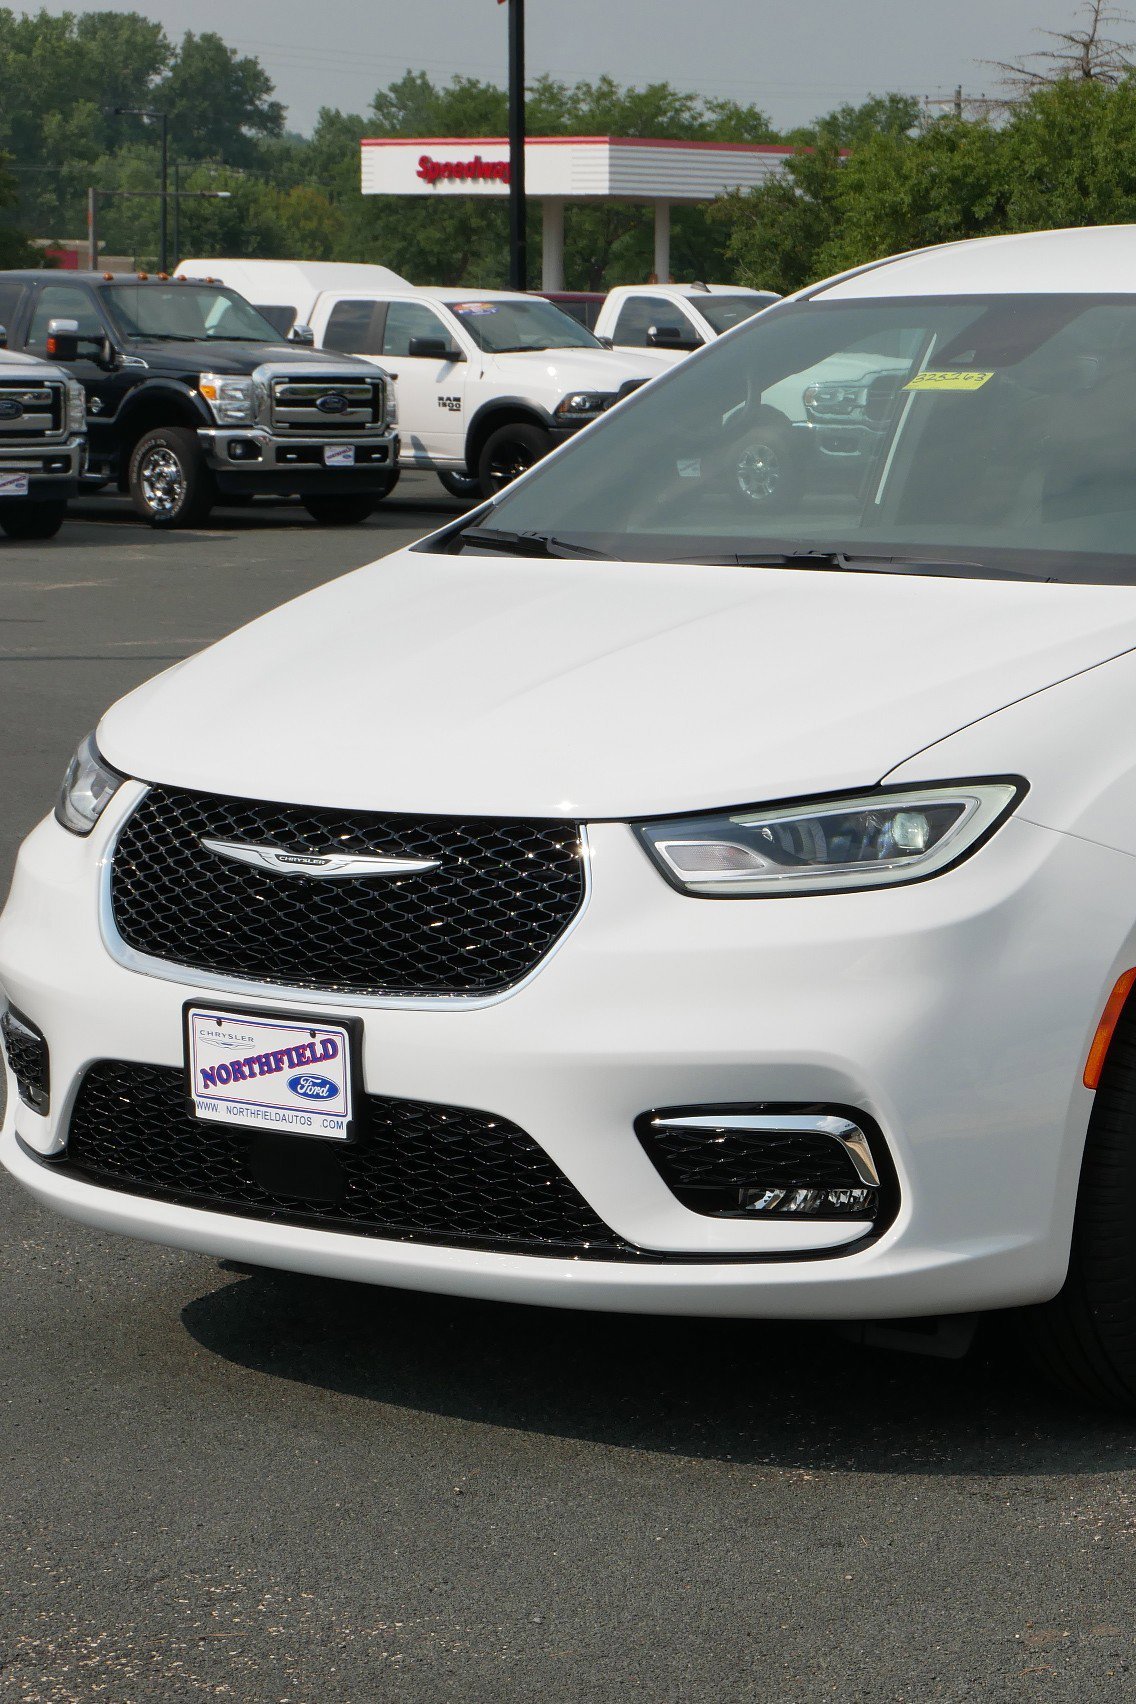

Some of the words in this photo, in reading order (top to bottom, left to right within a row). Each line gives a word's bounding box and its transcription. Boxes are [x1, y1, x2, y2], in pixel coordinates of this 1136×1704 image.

[438, 401, 462, 409] 1500
[279, 856, 326, 865] CHRYSLER
[199, 1029, 255, 1043] CHRYSLER
[200, 1037, 339, 1090] NORTHFIELD
[297, 1076, 330, 1096] Ford
[226, 1105, 313, 1127] NORTHFIELDAUTOS
